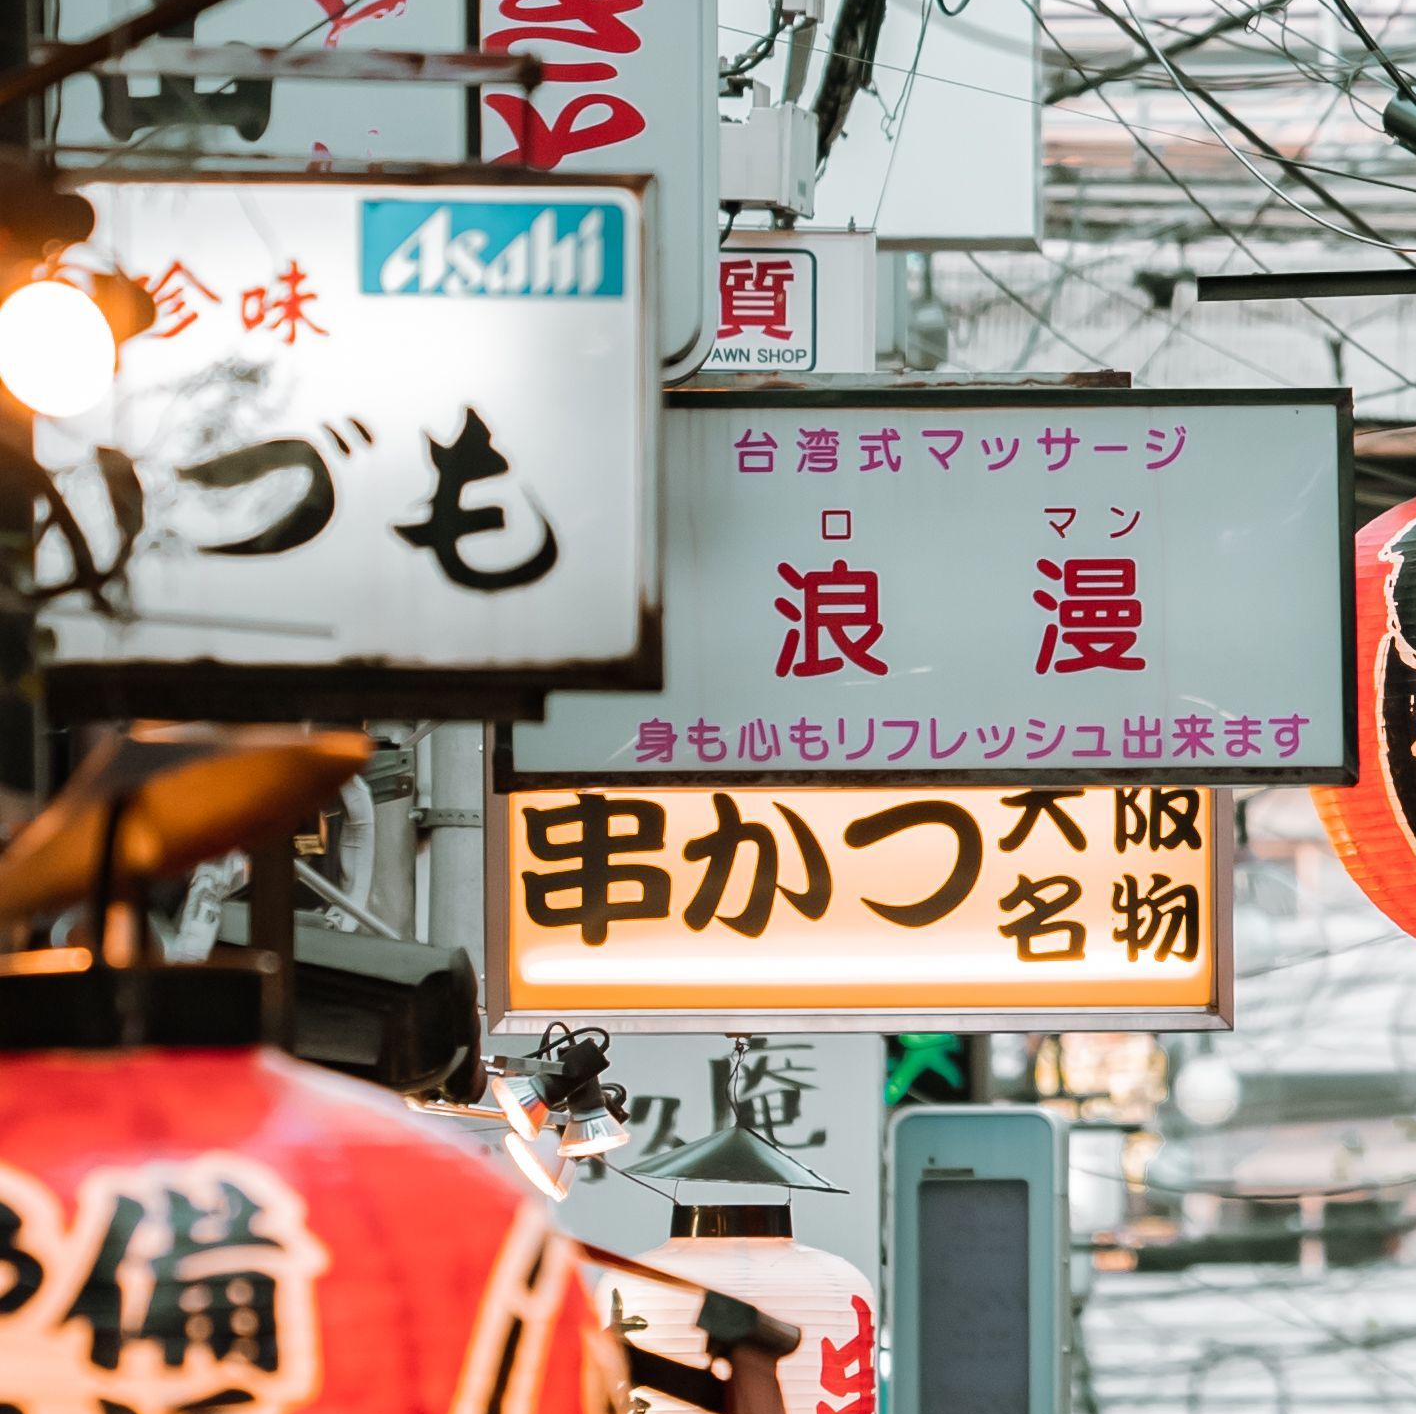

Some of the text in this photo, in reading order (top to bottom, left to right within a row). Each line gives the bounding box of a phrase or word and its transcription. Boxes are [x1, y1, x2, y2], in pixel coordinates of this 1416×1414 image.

[380, 207, 607, 296] Asahi
[716, 259, 795, 341] 質
[710, 347, 808, 364] AWN SHOP
[733, 426, 1188, 474] 台湾式マッサージ
[773, 557, 1147, 679] 浪漫
[634, 713, 1312, 763] 身も心もリフレッシュ出来ます
[999, 787, 1203, 855] 大阪
[520, 791, 985, 947] 串かつ
[999, 874, 1201, 963] 名物
